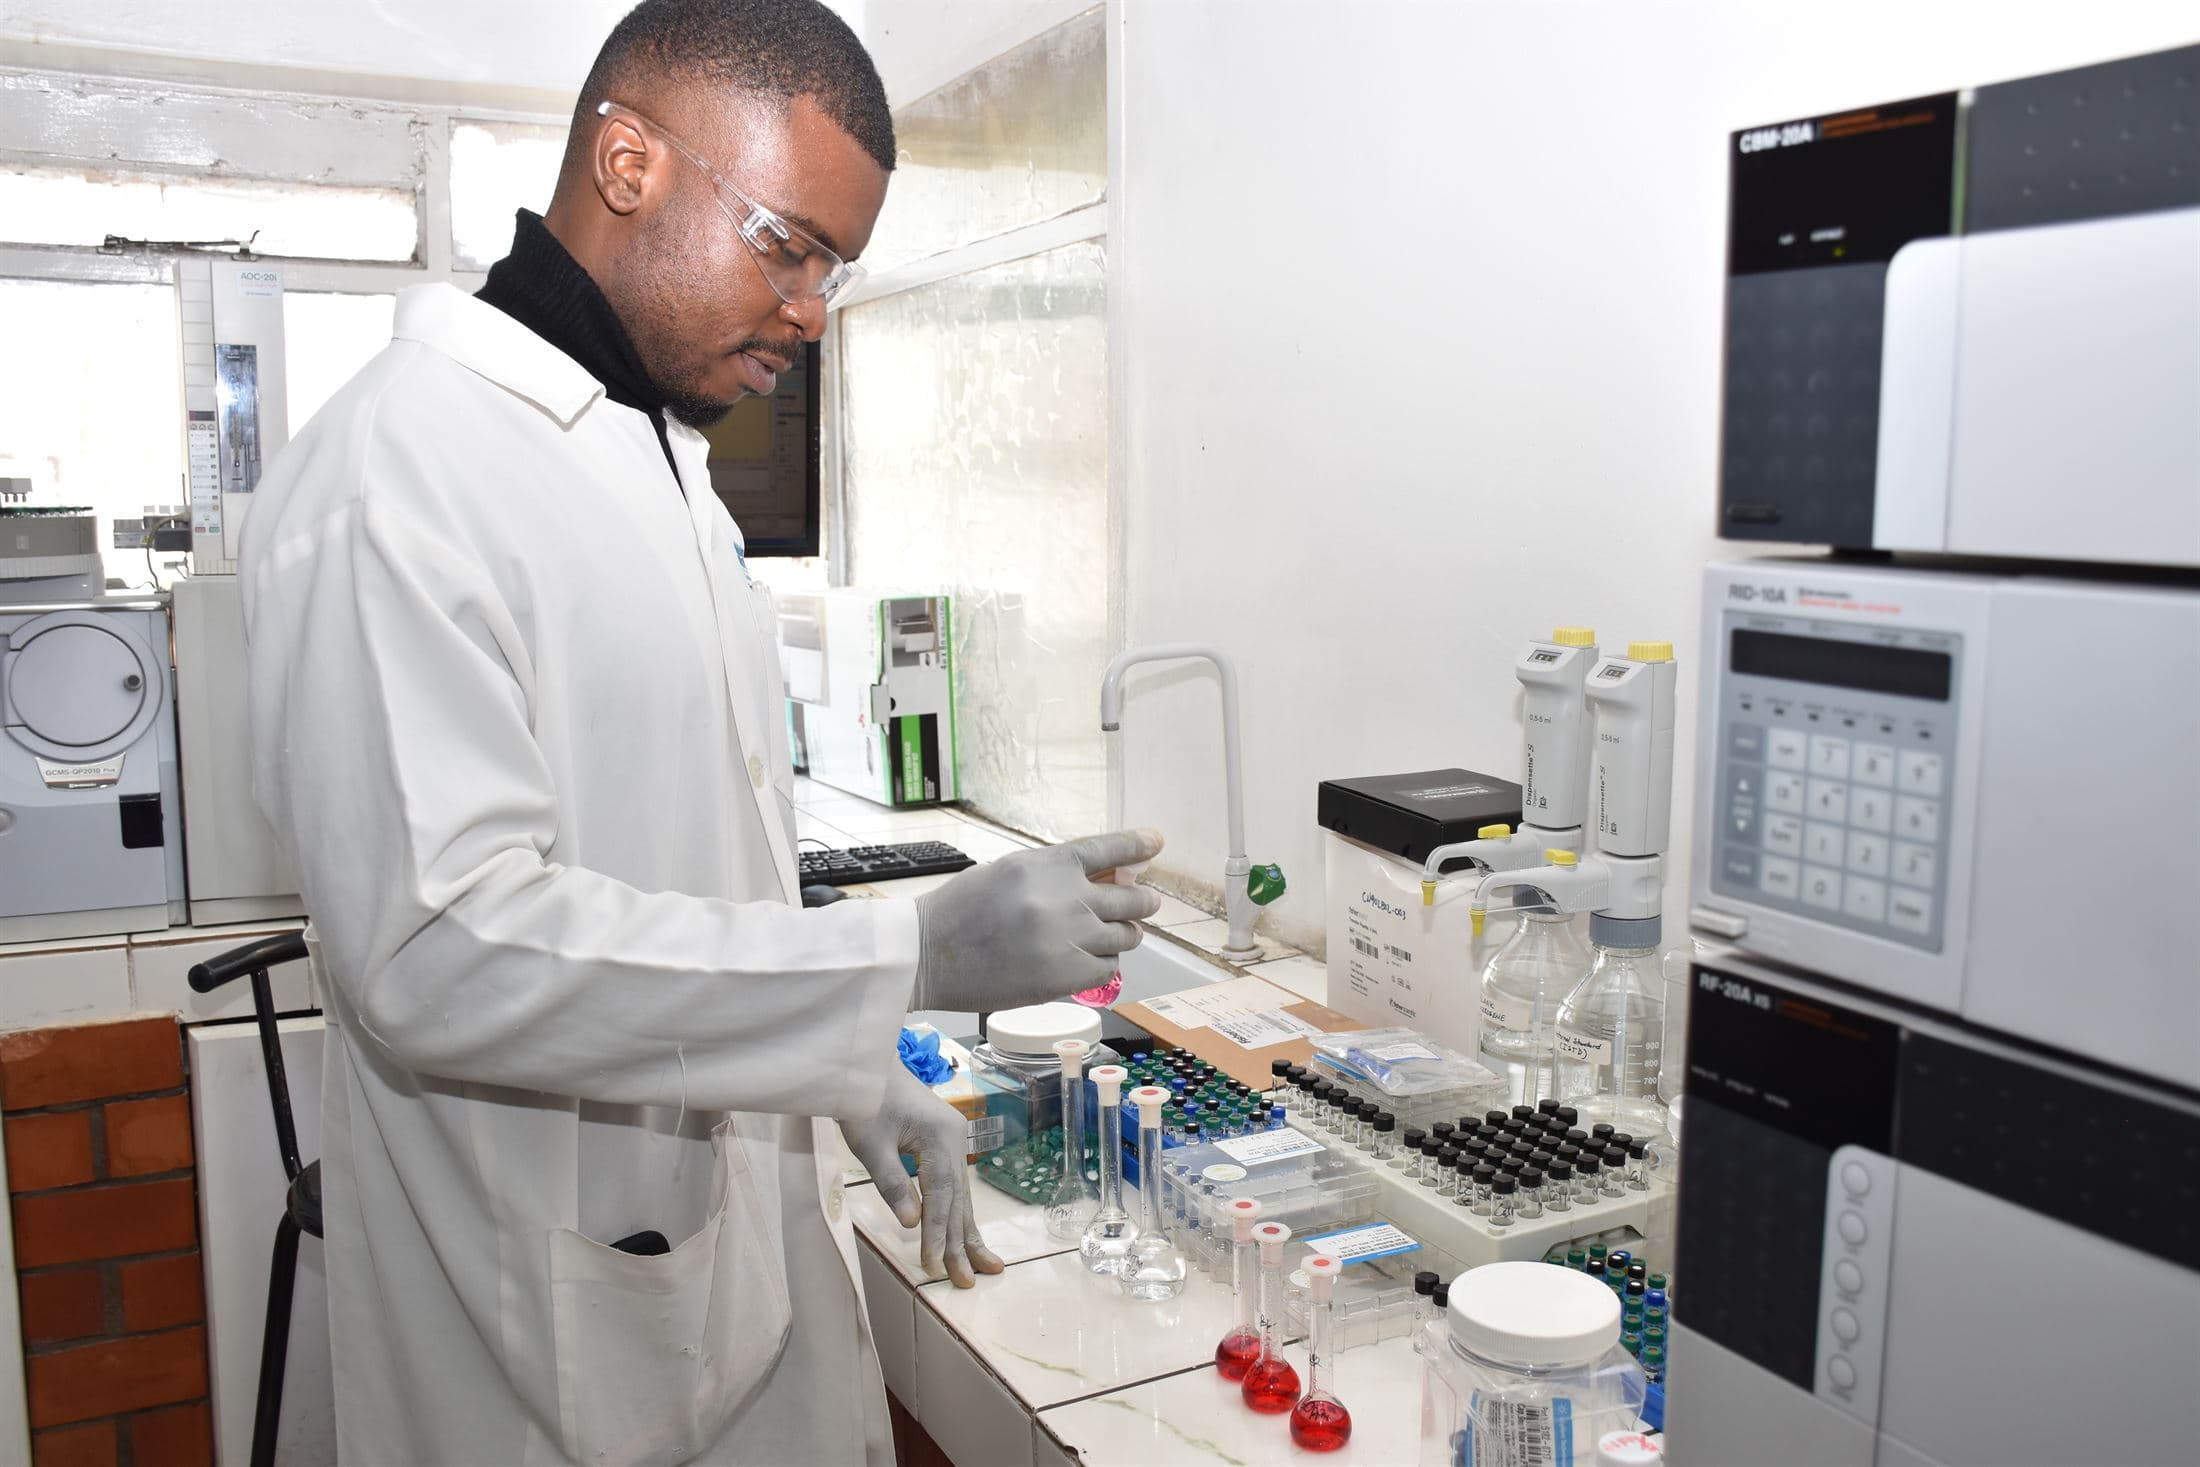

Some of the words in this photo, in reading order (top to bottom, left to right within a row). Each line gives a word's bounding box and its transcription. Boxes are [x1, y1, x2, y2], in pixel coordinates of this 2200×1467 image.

[1739, 122, 1814, 154] CBM-20A
[240, 272, 278, 281] AOC-20i
[1728, 583, 1787, 603] RID-10A
[1699, 972, 1751, 1003] RF-20A
[1645, 1041, 1659, 1050] 900
[1644, 1059, 1658, 1068] 800
[1643, 1076, 1657, 1085] 700
